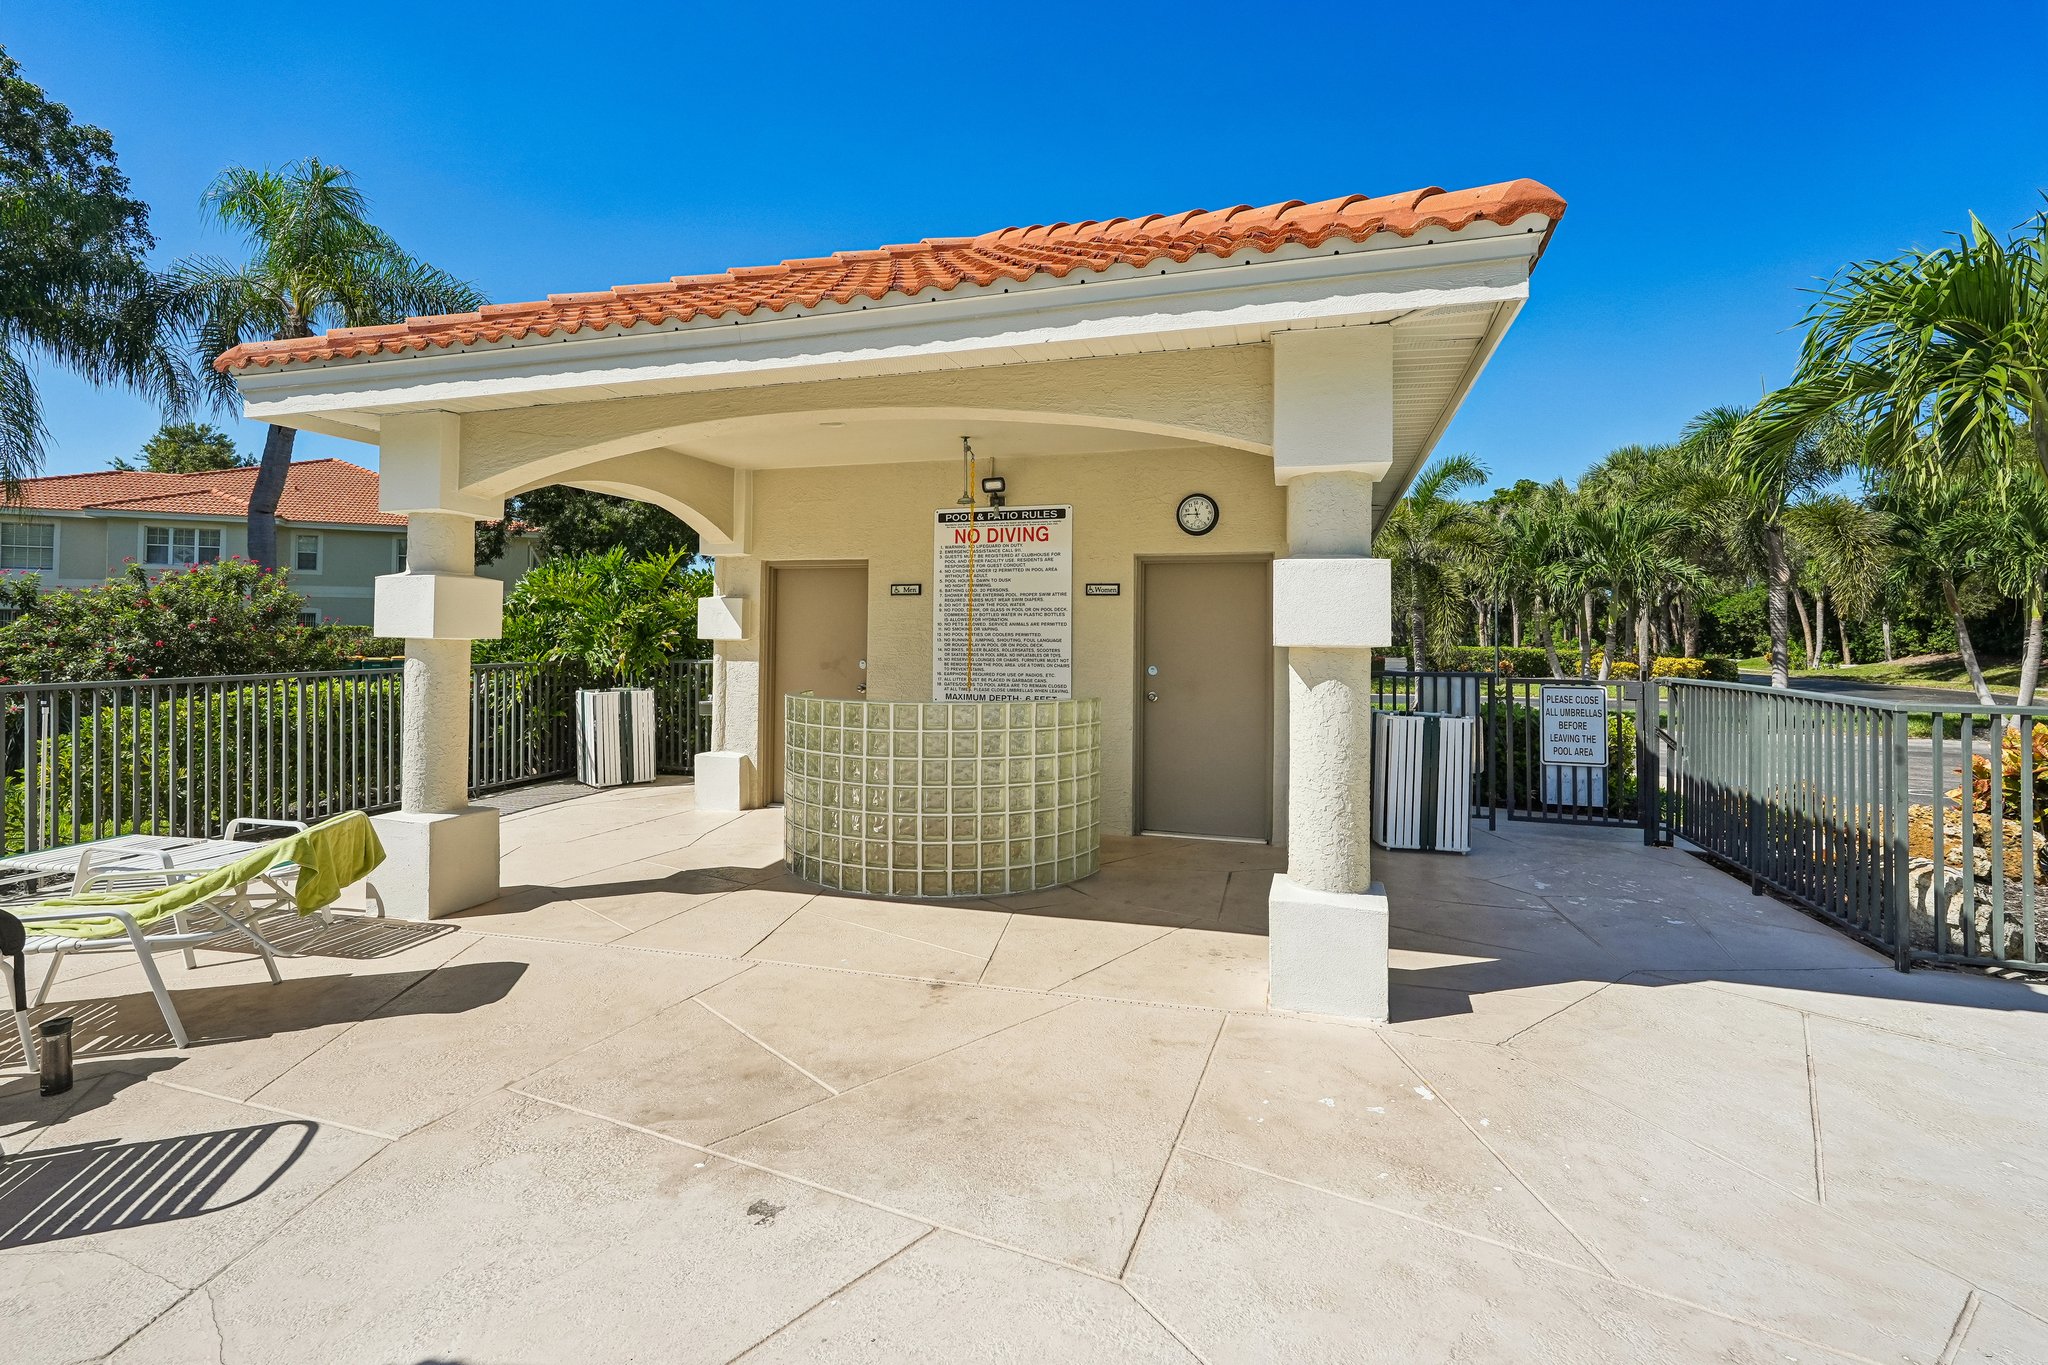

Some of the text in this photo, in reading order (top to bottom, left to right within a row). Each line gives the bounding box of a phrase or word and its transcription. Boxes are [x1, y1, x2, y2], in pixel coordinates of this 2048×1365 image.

[1022, 510, 1058, 518] RULES
[955, 526, 1049, 544] NO DIVING
[1547, 695, 1599, 704] PLEASE CLOSE
[1560, 709, 1602, 718] UMBRELLAS
[1559, 721, 1587, 730] BEFORE
[1550, 734, 1596, 743] LEAVING THE
[1554, 747, 1593, 756] POOL AREA
